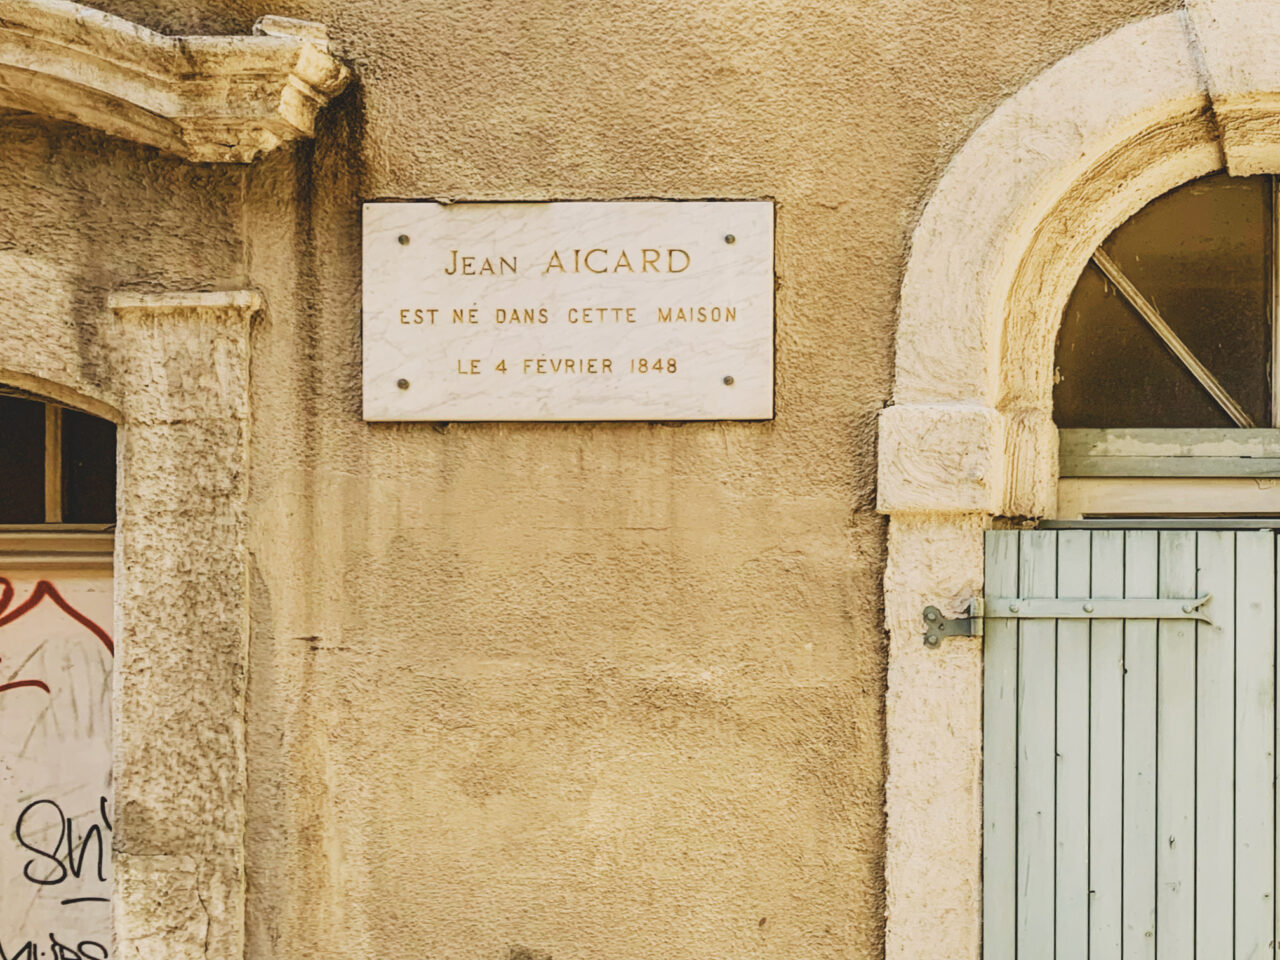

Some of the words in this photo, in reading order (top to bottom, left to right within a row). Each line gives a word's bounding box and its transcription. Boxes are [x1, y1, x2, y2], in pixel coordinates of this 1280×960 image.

[543, 248, 691, 275] AICARD
[399, 308, 439, 325] EST
[452, 302, 479, 325] NÉ
[495, 307, 549, 325] DANS
[567, 307, 637, 324] CETTE
[657, 306, 737, 324] MAISON
[457, 358, 481, 375] LE
[494, 358, 508, 375] 4
[629, 357, 678, 374] 1848
